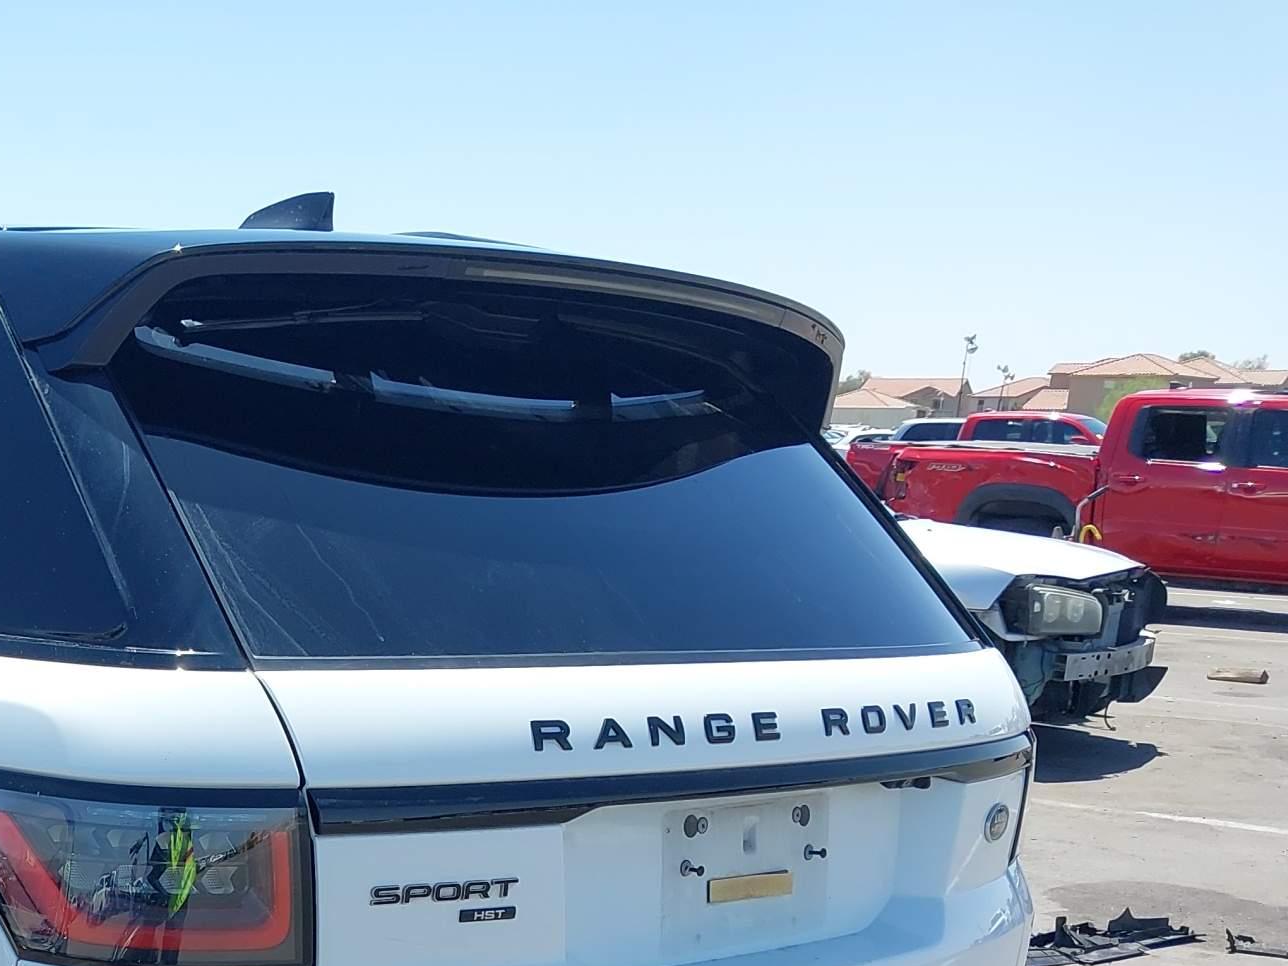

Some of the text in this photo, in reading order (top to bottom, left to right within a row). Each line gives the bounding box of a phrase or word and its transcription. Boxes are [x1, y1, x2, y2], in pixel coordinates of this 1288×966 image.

[530, 698, 977, 752] RANGE ROVER
[369, 877, 520, 906] SPORT
[473, 909, 506, 921] HST
